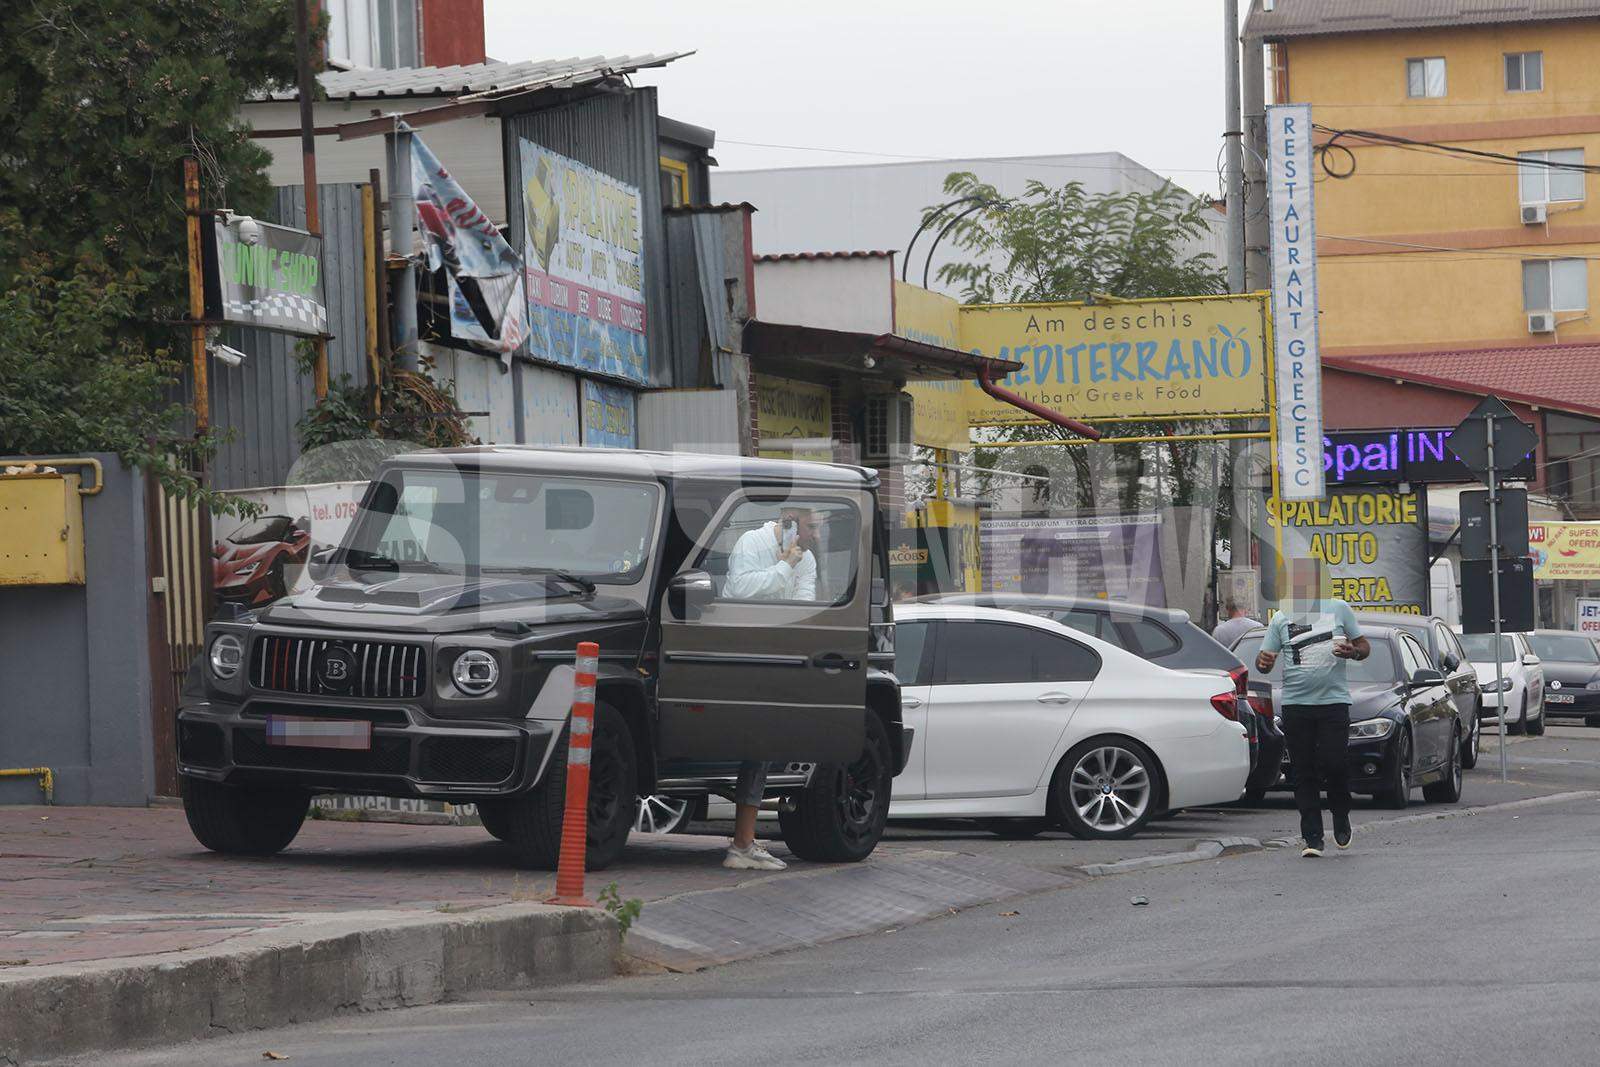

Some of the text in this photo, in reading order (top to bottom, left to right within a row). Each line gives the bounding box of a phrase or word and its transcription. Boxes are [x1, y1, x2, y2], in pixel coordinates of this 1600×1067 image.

[1283, 117, 1309, 486] RESTAURANT GRECESC
[1025, 307, 1193, 334] Am deschis
[1086, 388, 1144, 403] Greek
[1156, 384, 1202, 400] Food
[1265, 492, 1418, 527] SPALATORIE
[1568, 529, 1599, 537] SUPER
[1309, 532, 1378, 565] AUTO
[1581, 621, 1600, 632] OFE
